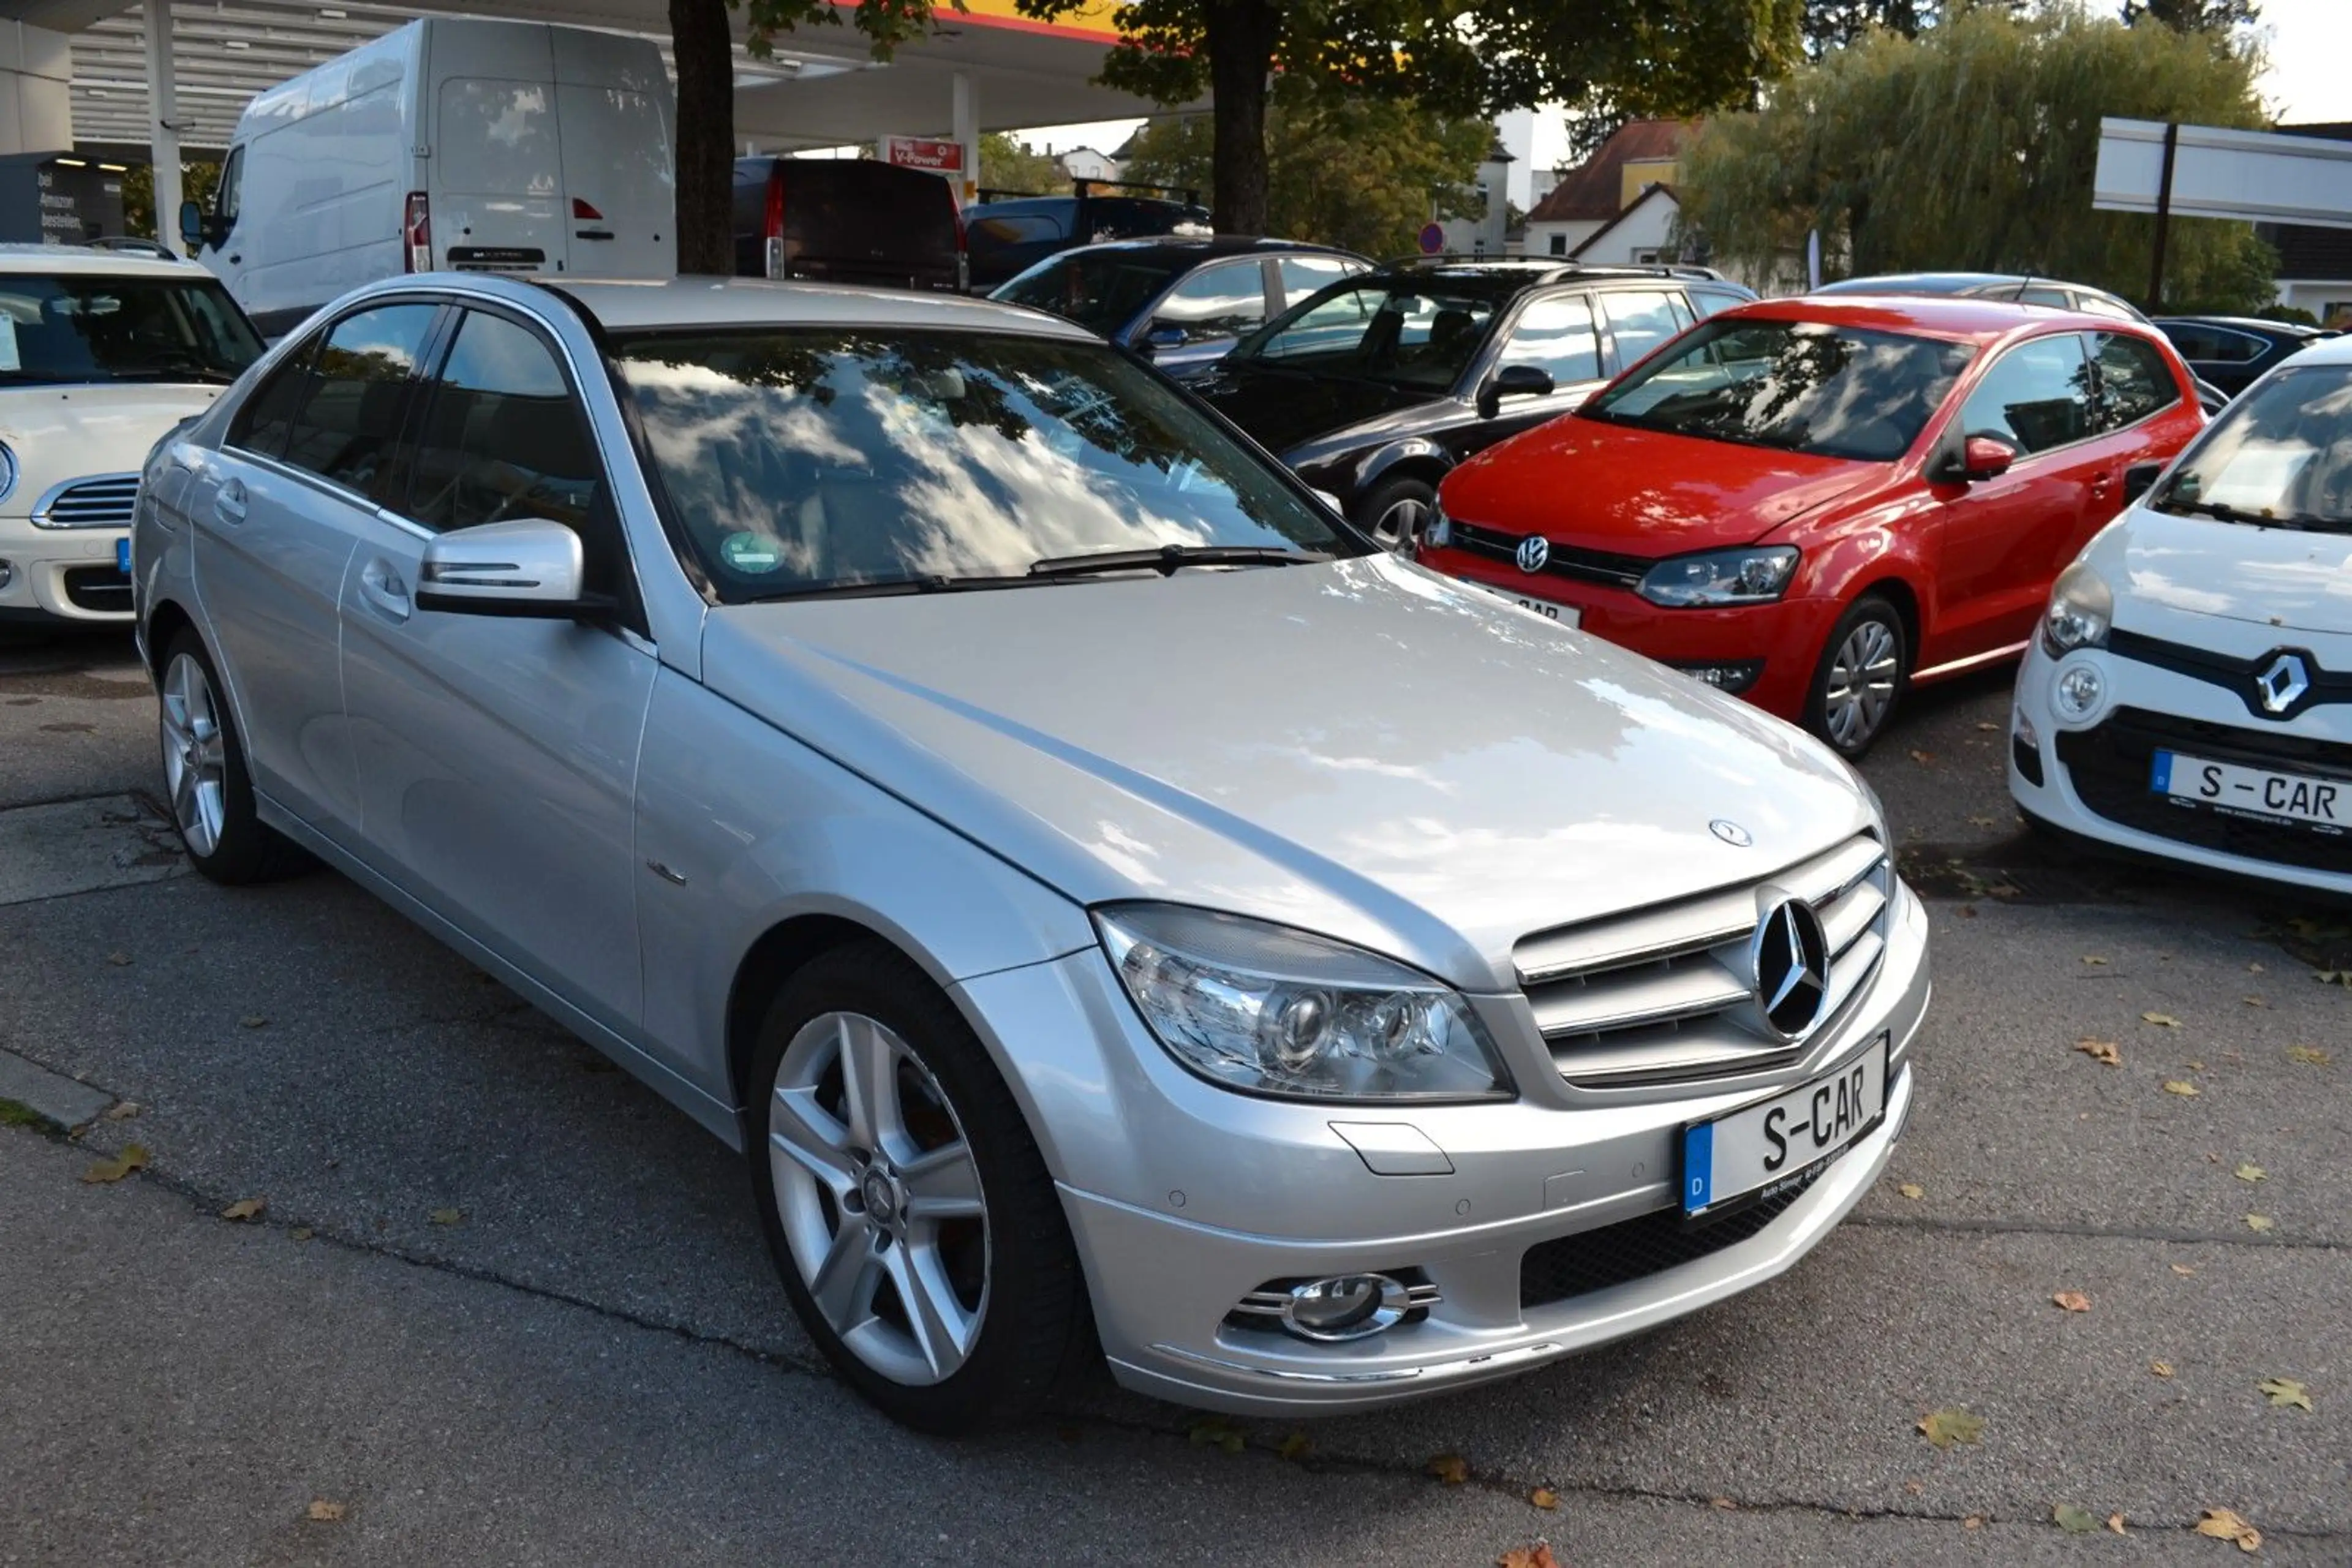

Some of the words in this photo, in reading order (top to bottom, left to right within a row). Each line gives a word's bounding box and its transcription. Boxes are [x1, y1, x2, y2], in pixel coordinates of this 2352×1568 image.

[895, 151, 943, 166] V-Power
[40, 192, 75, 208] Amazon
[1692, 1177, 1703, 1196] D
